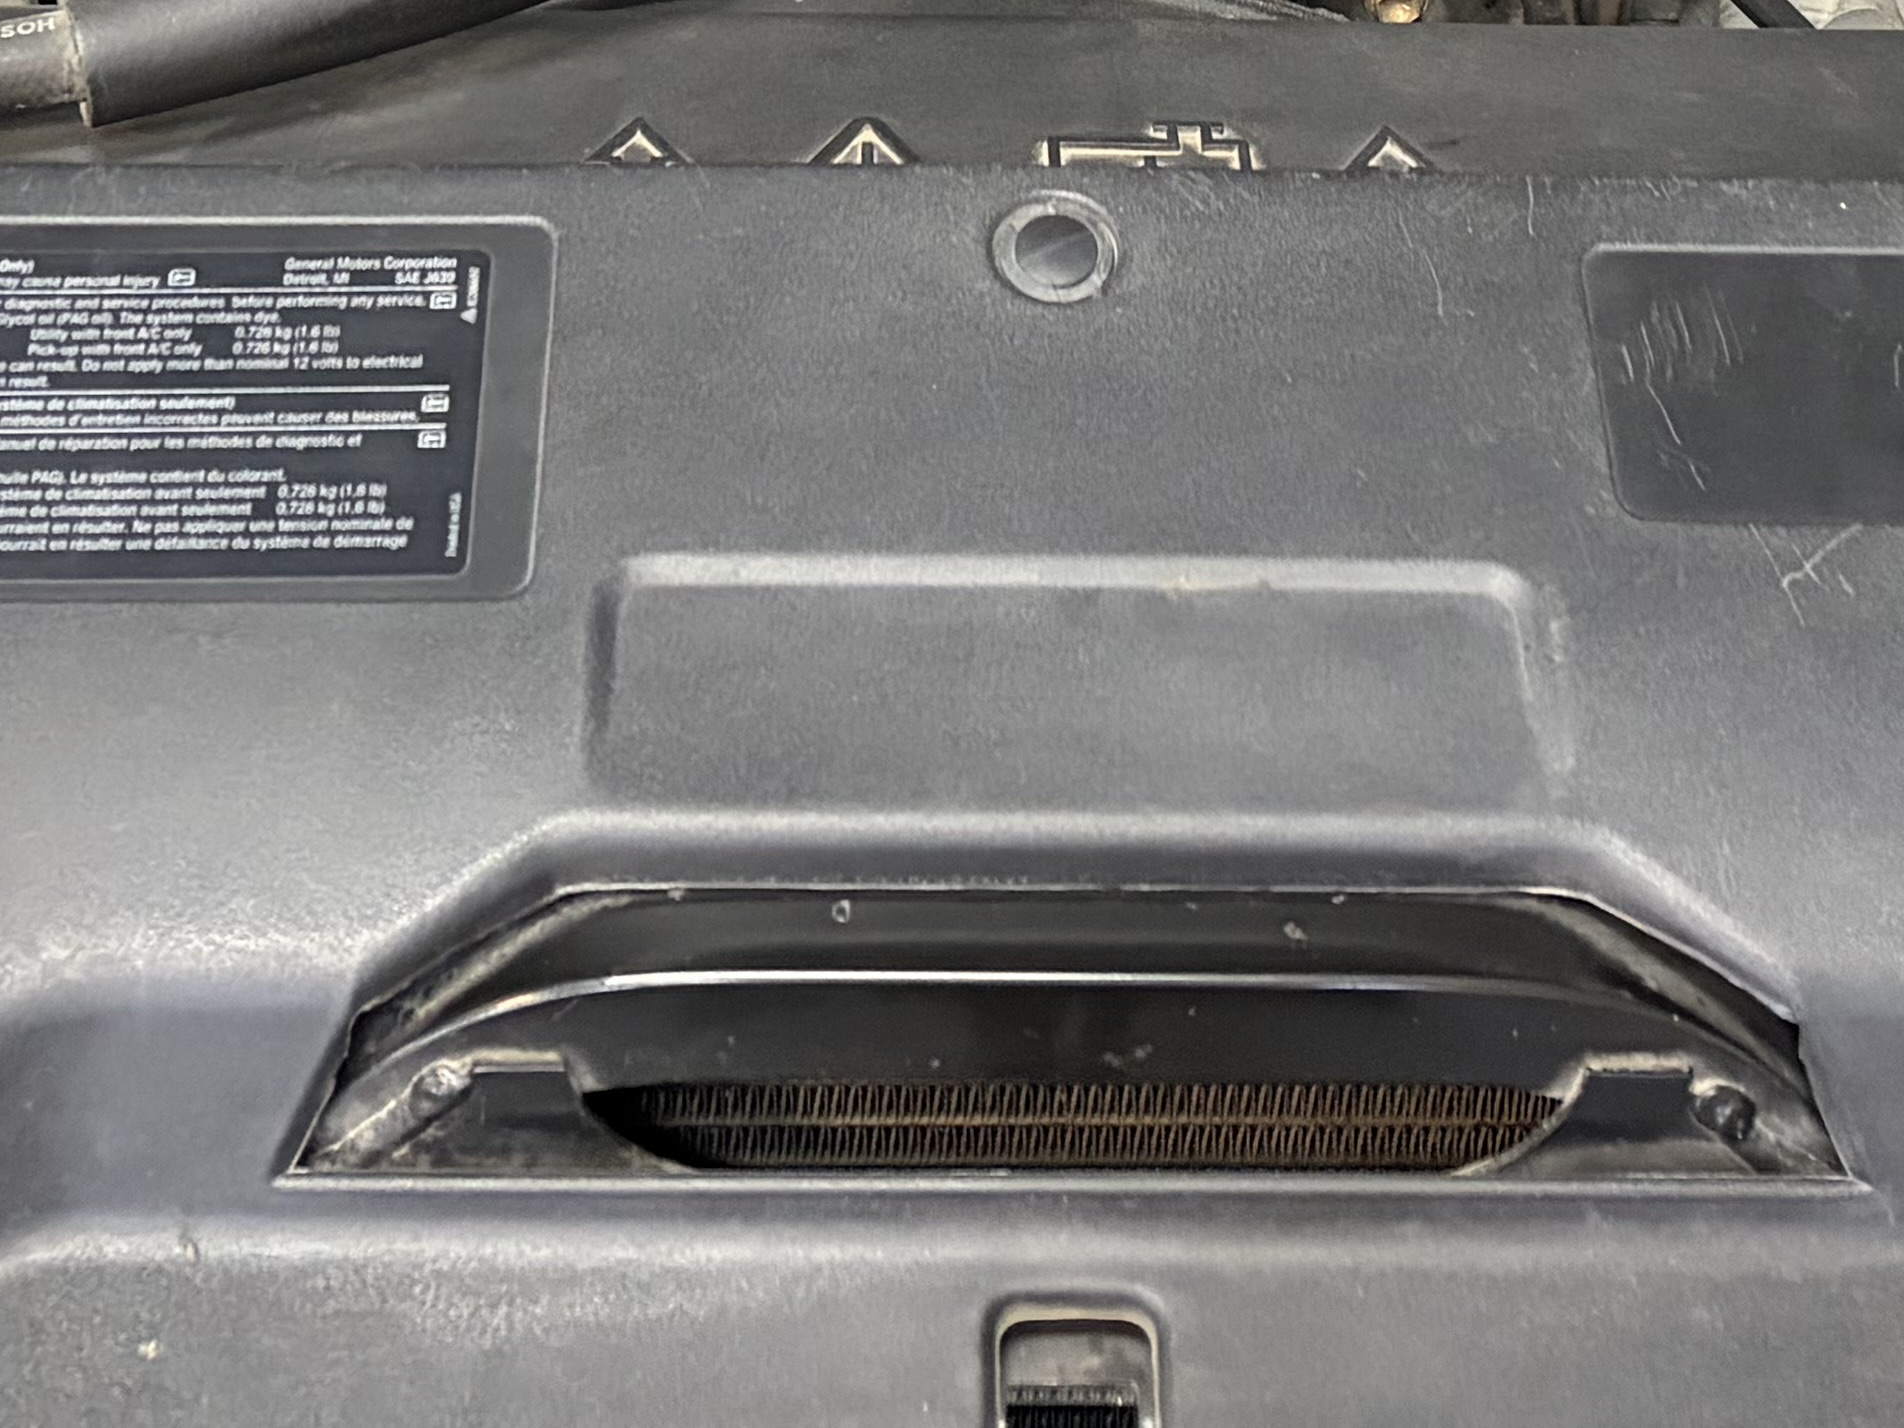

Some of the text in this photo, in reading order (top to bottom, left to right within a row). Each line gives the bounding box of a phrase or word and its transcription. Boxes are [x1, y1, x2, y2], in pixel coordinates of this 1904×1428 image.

[284, 256, 457, 270] General Motors Corporation
[395, 272, 420, 283] SAE
